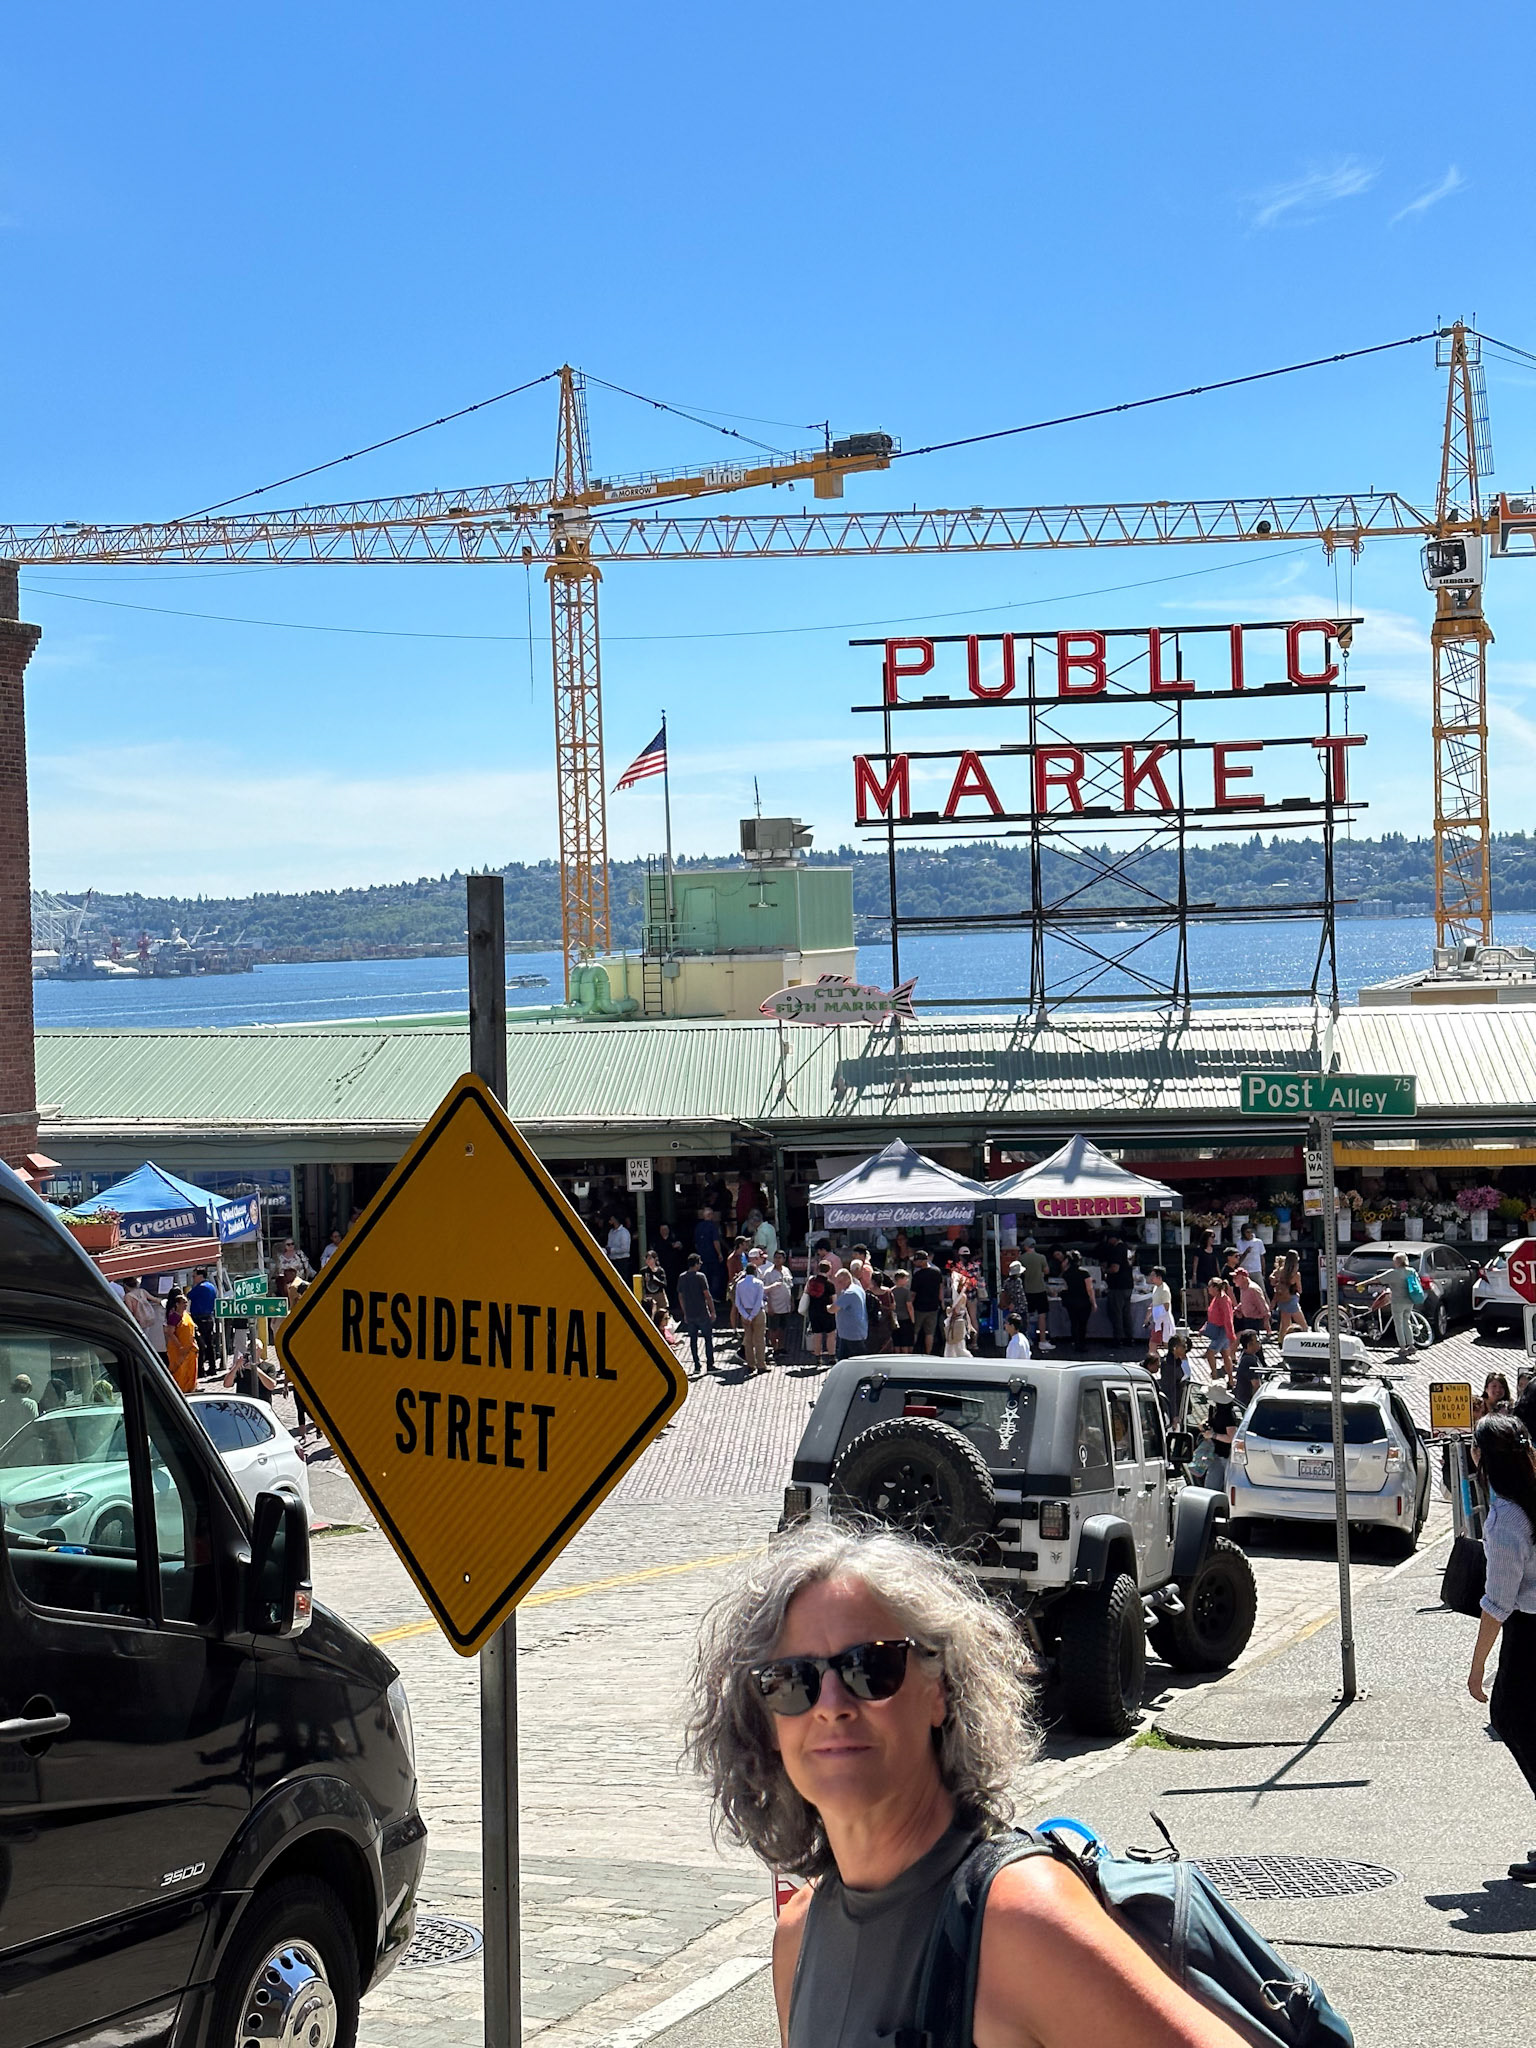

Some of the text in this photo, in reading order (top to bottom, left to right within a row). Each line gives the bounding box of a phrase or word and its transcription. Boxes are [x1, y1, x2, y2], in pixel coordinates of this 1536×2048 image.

[702, 467, 748, 486] Turner
[618, 487, 652, 498] MORROW
[884, 619, 1340, 704] PUBLIC
[853, 734, 1368, 821] MARKET
[814, 987, 861, 998] CITY
[775, 999, 898, 1014] FISH MARKET
[1248, 1076, 1411, 1114] Post Alley 75
[630, 1160, 649, 1169] ONE
[1308, 1152, 1322, 1162] ON
[629, 1169, 650, 1178] WAY
[1307, 1162, 1323, 1172] WA
[1037, 1196, 1142, 1217] CHERRIES
[828, 1209, 876, 1224] Cherries
[893, 1207, 925, 1222] Cider
[924, 1206, 974, 1221] Slushies
[129, 1211, 197, 1238] Cream
[1512, 1260, 1536, 1286] ST
[241, 1280, 255, 1296] Pine
[220, 1300, 248, 1315] Pike
[254, 1304, 265, 1315] Pl
[341, 1288, 618, 1381] RESIDENTIAL
[1300, 1341, 1330, 1349] YAKIM
[1433, 1395, 1469, 1403] LOAD AND
[1436, 1403, 1466, 1411] UNLOAD
[1442, 1412, 1461, 1420] ONLY
[395, 1387, 556, 1472] STREET
[160, 1860, 206, 1887] 3500
